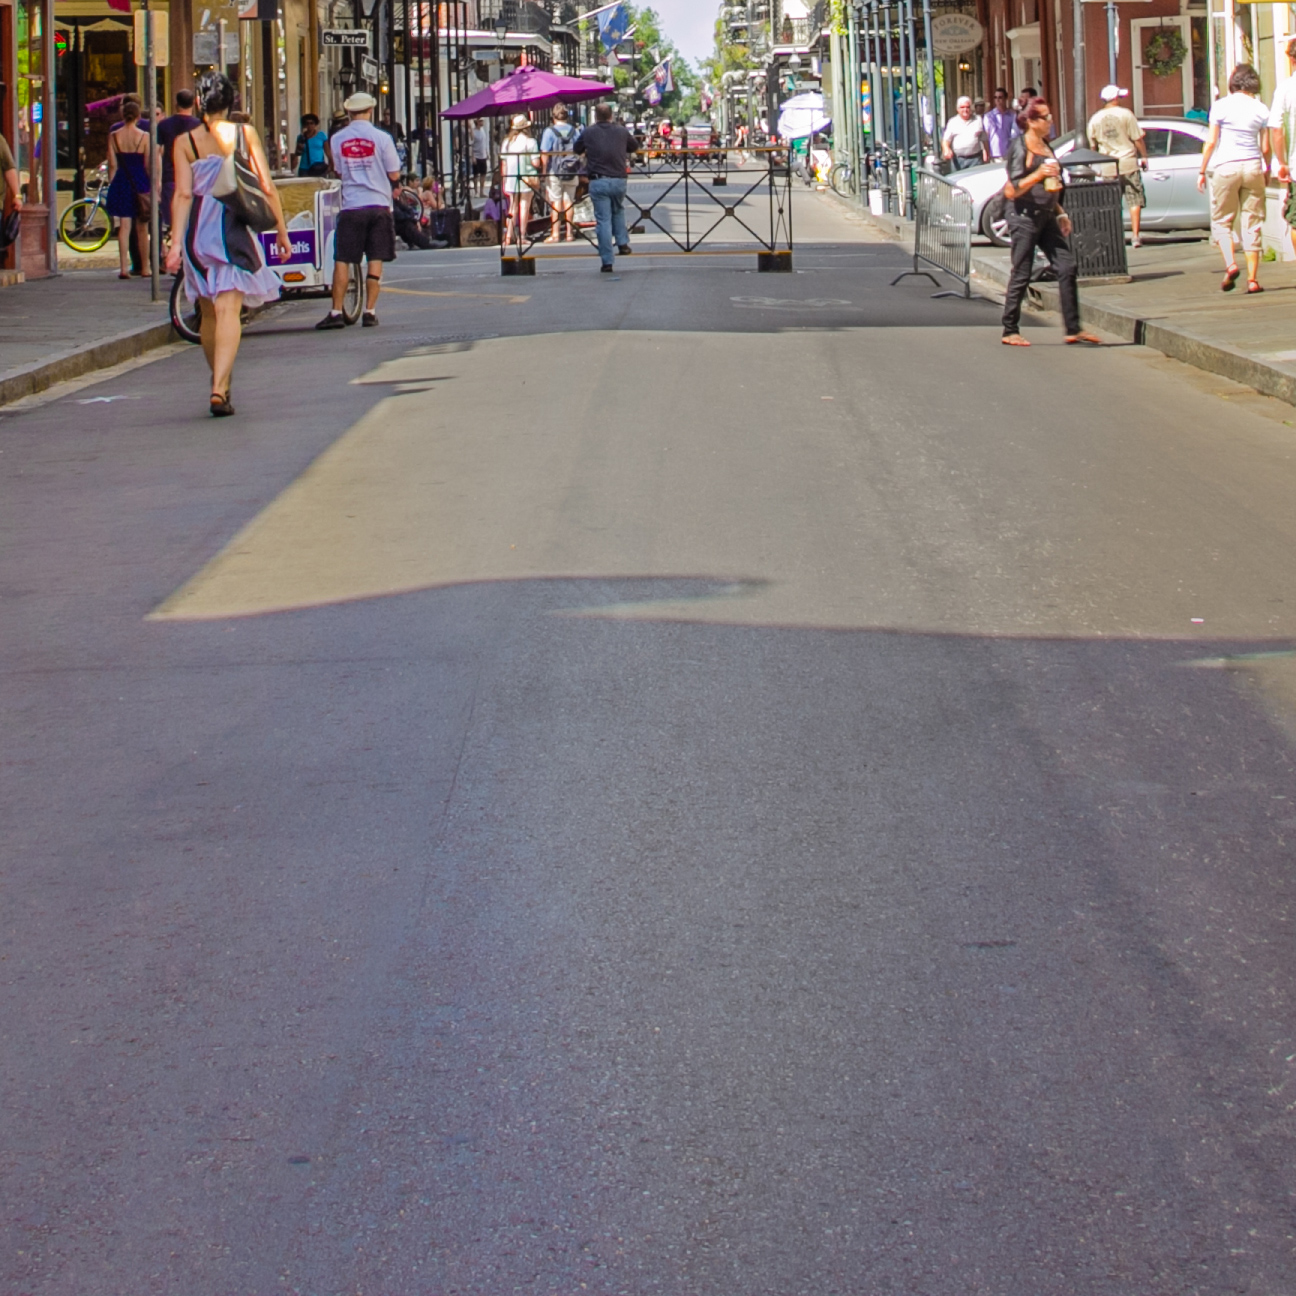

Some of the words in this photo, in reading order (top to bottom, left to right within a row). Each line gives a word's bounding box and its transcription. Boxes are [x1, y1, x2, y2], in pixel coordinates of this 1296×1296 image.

[933, 16, 976, 31] FOREVER
[325, 34, 337, 44] St.
[341, 34, 365, 44] Peter
